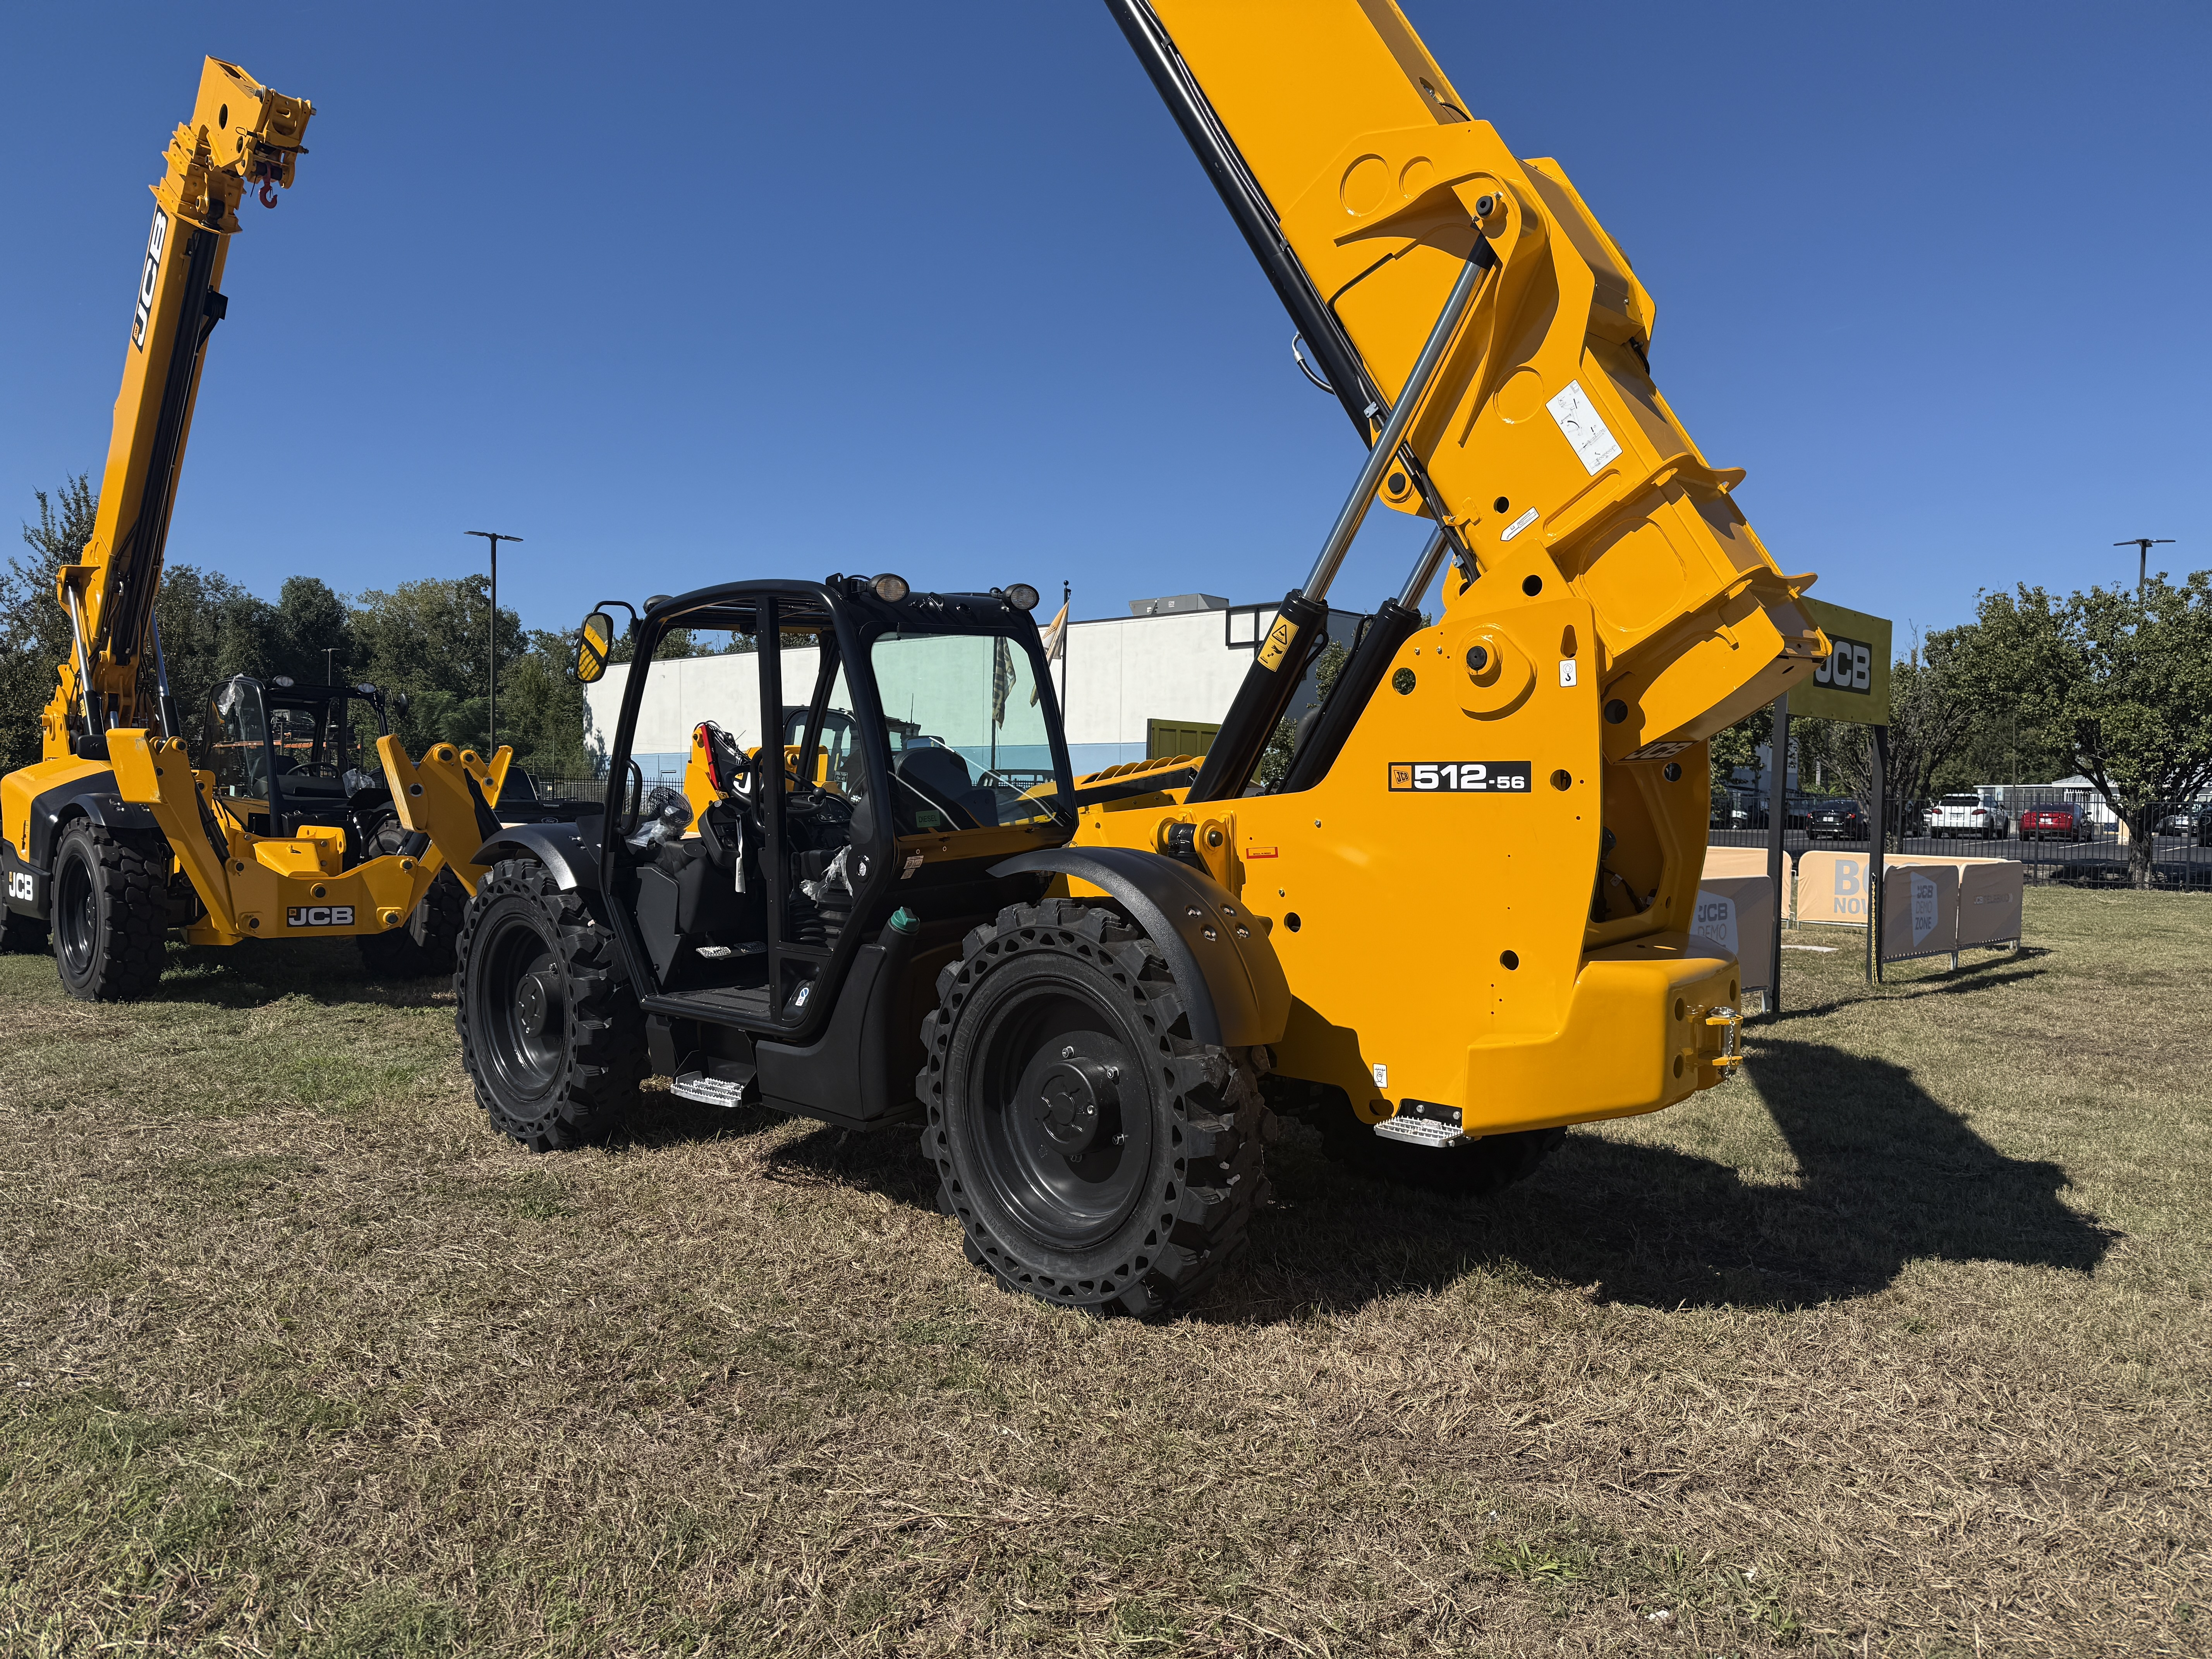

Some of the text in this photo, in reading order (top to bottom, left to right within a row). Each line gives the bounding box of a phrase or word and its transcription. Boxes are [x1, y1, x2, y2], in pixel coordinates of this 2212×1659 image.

[137, 211, 166, 346] JCB
[1625, 742, 1693, 759] JCB
[1396, 772, 1408, 782] JCB
[9, 872, 33, 901] JCB
[1917, 885, 1933, 898] JCB
[1698, 903, 1728, 922] JCB
[1916, 900, 1932, 914] DEMO
[289, 907, 353, 925] JCB
[1915, 917, 1932, 930] ZONE
[1698, 923, 1726, 941] DEMO
